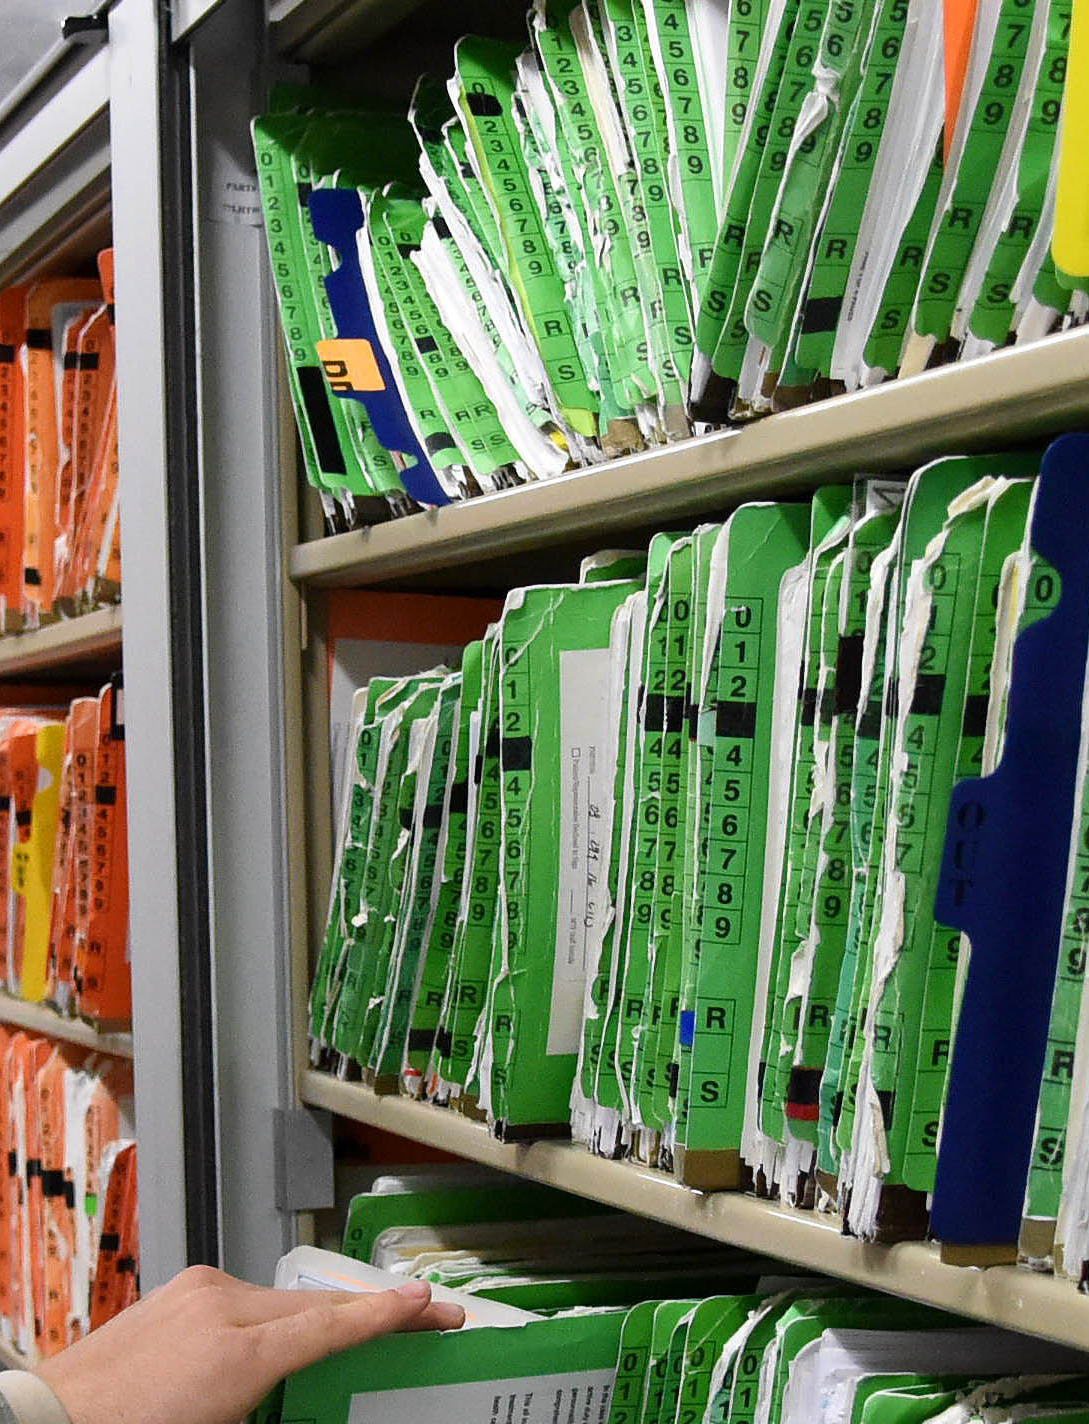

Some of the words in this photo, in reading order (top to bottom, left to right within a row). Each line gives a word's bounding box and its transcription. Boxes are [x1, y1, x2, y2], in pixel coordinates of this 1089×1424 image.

[664, 14, 679, 30] 4
[617, 26, 632, 41] 3
[737, 30, 750, 52] 7
[1009, 24, 1025, 48] 7
[669, 41, 683, 58] 5
[796, 46, 813, 67] 6
[882, 37, 899, 58] 6
[557, 58, 573, 72] 2
[623, 52, 637, 67] 4
[674, 69, 689, 86] 6
[734, 66, 748, 89] 8
[876, 73, 892, 94] 7
[994, 64, 1014, 87] 8
[563, 80, 579, 95] 3
[627, 78, 643, 94] 5
[790, 82, 806, 102] 7
[571, 102, 585, 116] 4
[633, 105, 647, 121] 6
[678, 97, 691, 114] 7
[732, 103, 747, 125] 9
[985, 102, 1003, 124] 9
[1041, 100, 1060, 124] 9
[484, 120, 498, 132] 2
[778, 116, 796, 137] 8
[863, 108, 881, 128] 8
[578, 124, 593, 140] 5
[637, 131, 651, 148] 7
[684, 126, 699, 144] 8
[491, 140, 503, 152] 3
[855, 142, 872, 162] 9
[261, 152, 272, 166] 0
[497, 159, 510, 170] 4
[643, 158, 659, 174] 8
[688, 156, 703, 174] 9
[771, 152, 787, 171] 9
[265, 174, 273, 188] 1
[503, 178, 517, 191] 5
[649, 185, 663, 201] 9
[268, 196, 281, 210] 2
[509, 198, 523, 211] 6
[271, 219, 282, 232] 3
[515, 218, 527, 232] 7
[949, 208, 972, 228] R
[1010, 216, 1033, 239] R
[773, 219, 793, 245] R
[275, 242, 285, 255] 4
[523, 240, 536, 254] 8
[826, 239, 847, 258] R
[278, 263, 289, 277] 5
[529, 261, 542, 274] 9
[663, 268, 682, 286] R
[281, 285, 293, 298] 6
[929, 273, 950, 293] S
[753, 290, 772, 312] S
[987, 284, 1009, 302] S
[285, 306, 296, 320] 7
[291, 327, 303, 340] 8
[545, 320, 562, 336] R
[675, 326, 692, 345] S
[293, 348, 307, 361] 9
[558, 365, 575, 380] S
[1035, 575, 1053, 601] 0
[675, 600, 689, 621] 0
[735, 607, 751, 628] 0
[674, 635, 684, 656] 1
[735, 641, 745, 662] 1
[507, 680, 516, 699] 1
[671, 670, 685, 691] 2
[731, 676, 746, 697] 2
[506, 712, 520, 732] 2
[668, 738, 681, 760] 4
[727, 745, 741, 766] 4
[507, 776, 521, 795] 4
[648, 772, 661, 792] 5
[725, 780, 739, 801] 5
[506, 808, 521, 828] 5
[645, 804, 659, 824] 6
[481, 821, 494, 839] 6
[723, 815, 737, 836] 6
[479, 849, 492, 866] 7
[506, 840, 520, 858] 6
[643, 838, 657, 858] 7
[721, 848, 737, 869] 7
[829, 859, 845, 881] 8
[475, 876, 488, 893] 8
[639, 871, 655, 891] 8
[717, 883, 732, 904] 8
[473, 904, 485, 920] 9
[825, 896, 841, 918] 9
[716, 917, 730, 938] 9
[459, 986, 477, 1004] R
[707, 1007, 725, 1028] R
[809, 1005, 828, 1027] R
[701, 1081, 718, 1102] S
[623, 1353, 637, 1372] 0
[691, 1347, 705, 1367] 0
[743, 1354, 757, 1375] 0
[620, 1382, 630, 1400] 1
[687, 1378, 697, 1398] 1
[741, 1388, 751, 1408] 1
